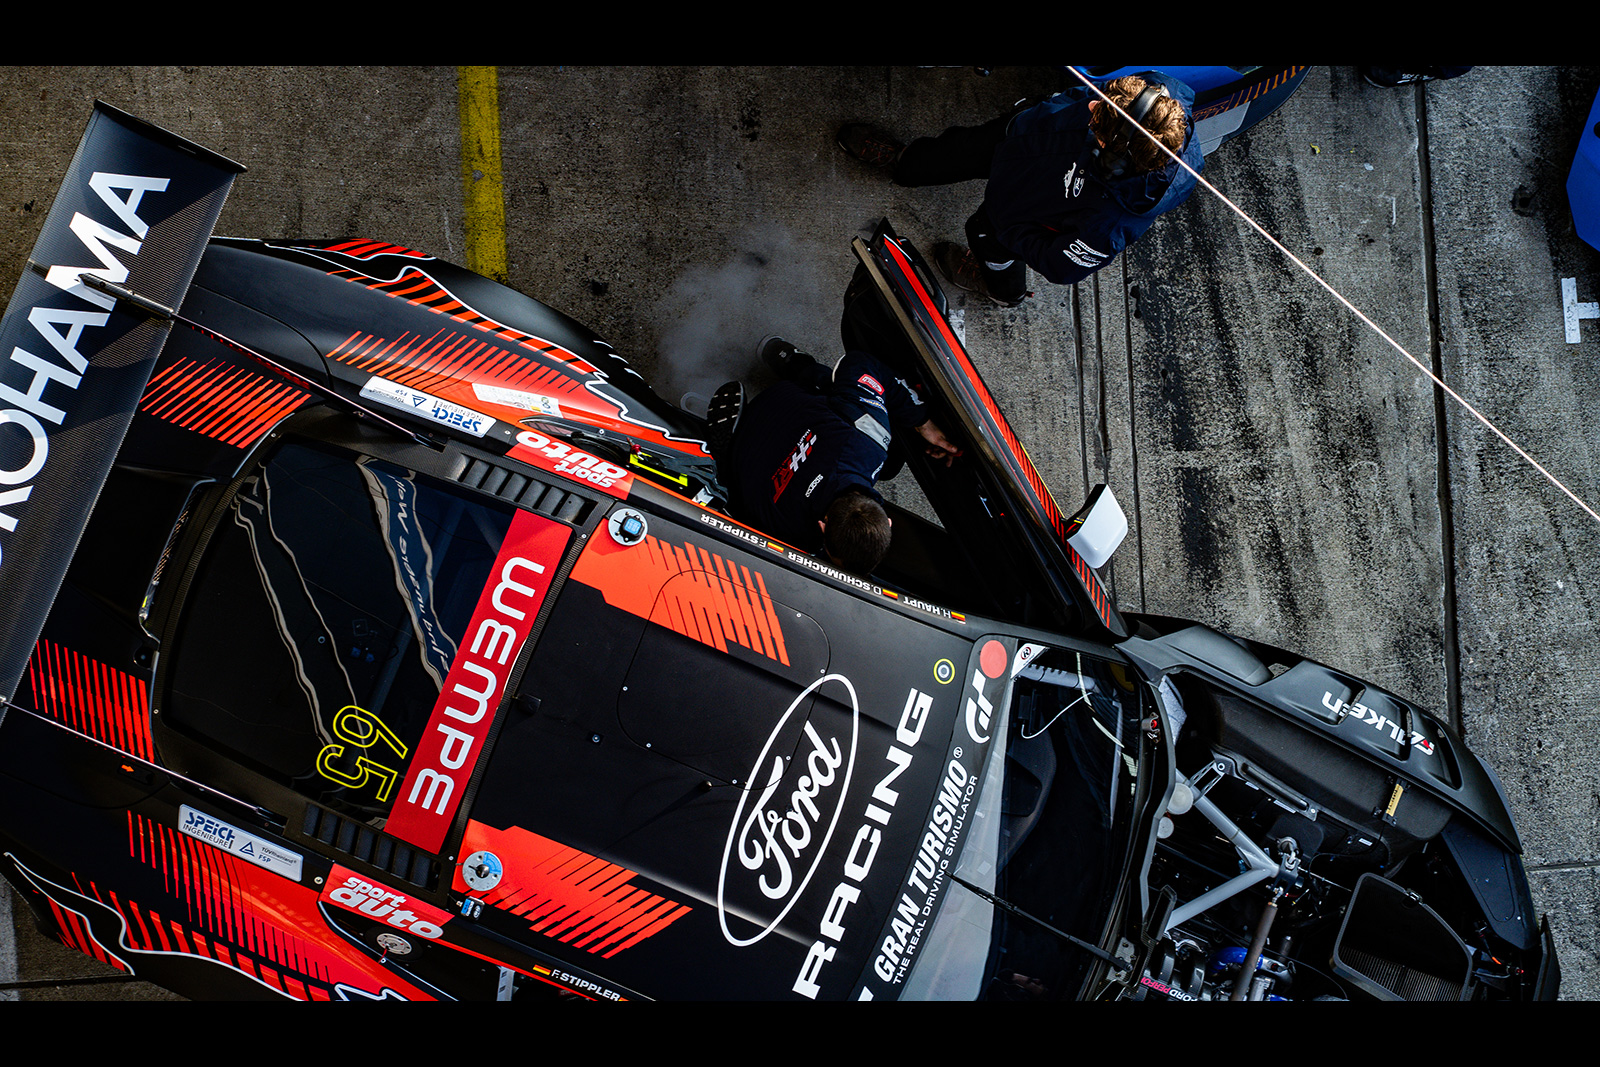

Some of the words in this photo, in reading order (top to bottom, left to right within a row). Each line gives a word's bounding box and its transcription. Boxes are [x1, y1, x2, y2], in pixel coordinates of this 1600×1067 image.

[515, 430, 628, 479] auto
[553, 460, 617, 489] sport
[408, 557, 545, 815] WEMPE
[316, 705, 408, 802] 65
[183, 823, 229, 848] INGENIEURE
[738, 720, 842, 900] Ford
[792, 687, 933, 1000] RACING
[329, 887, 444, 939] auto
[342, 876, 407, 907] sport
[892, 957, 910, 985] THE
[907, 918, 927, 955] REAL
[922, 859, 949, 917] DRIVING
[944, 775, 978, 857] SIMULATOR
[874, 893, 921, 983] GRAN
